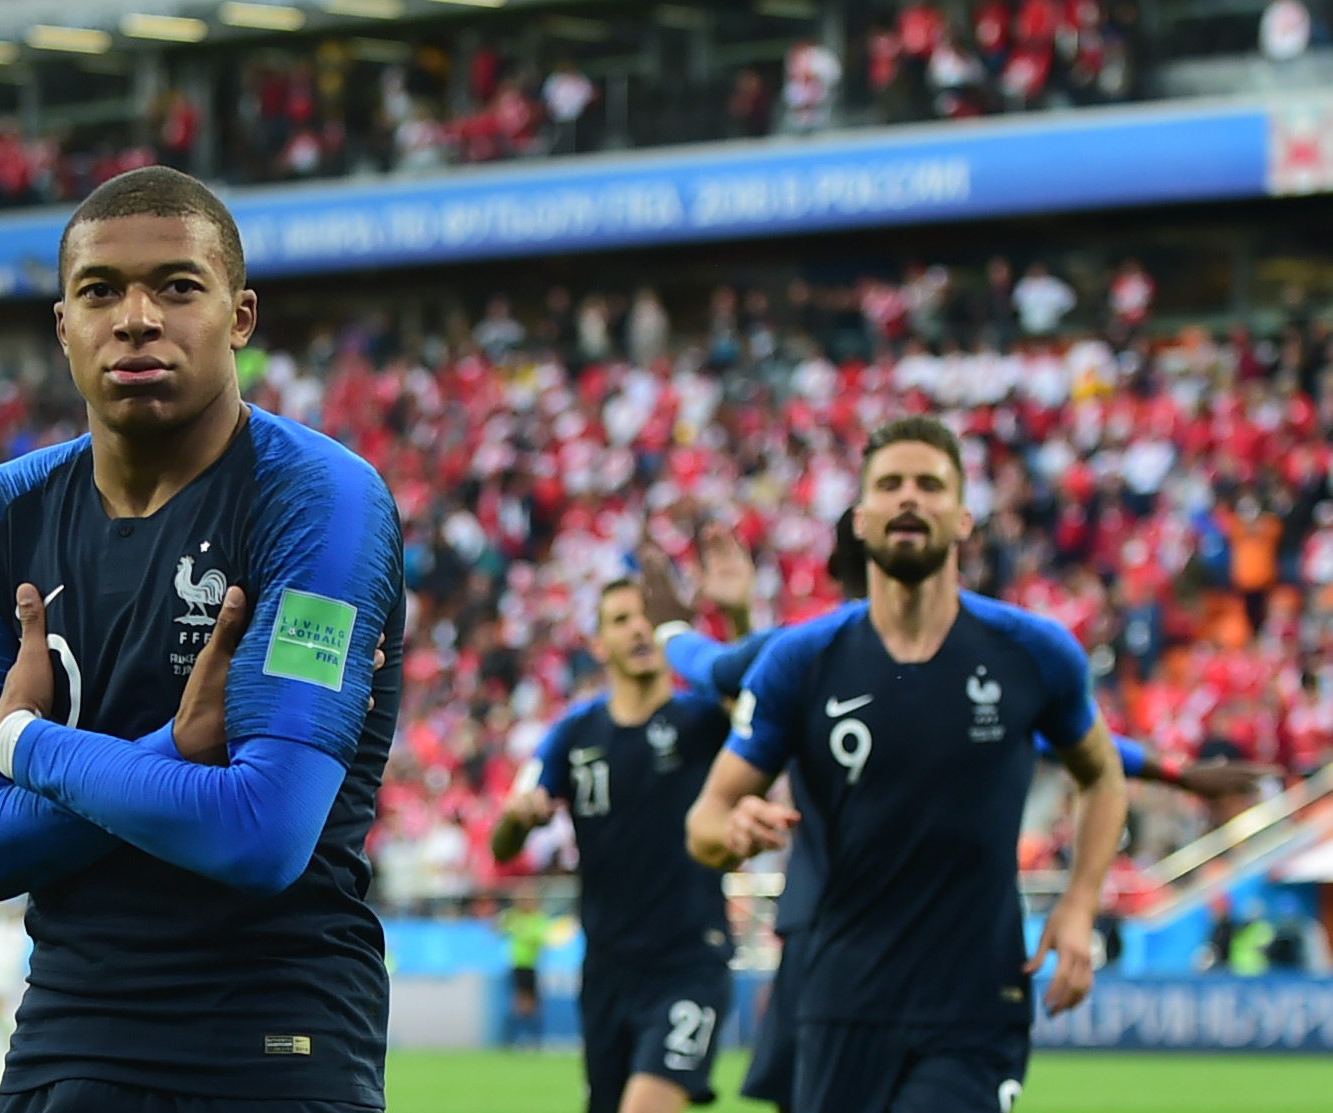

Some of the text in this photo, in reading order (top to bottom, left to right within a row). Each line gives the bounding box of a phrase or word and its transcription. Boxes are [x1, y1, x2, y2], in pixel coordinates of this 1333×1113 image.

[279, 626, 341, 648] FOOTBALL
[282, 616, 345, 639] LIVING
[315, 651, 339, 666] FIFA
[829, 718, 873, 784] 9
[571, 760, 610, 818] 21
[664, 999, 716, 1071] 21
